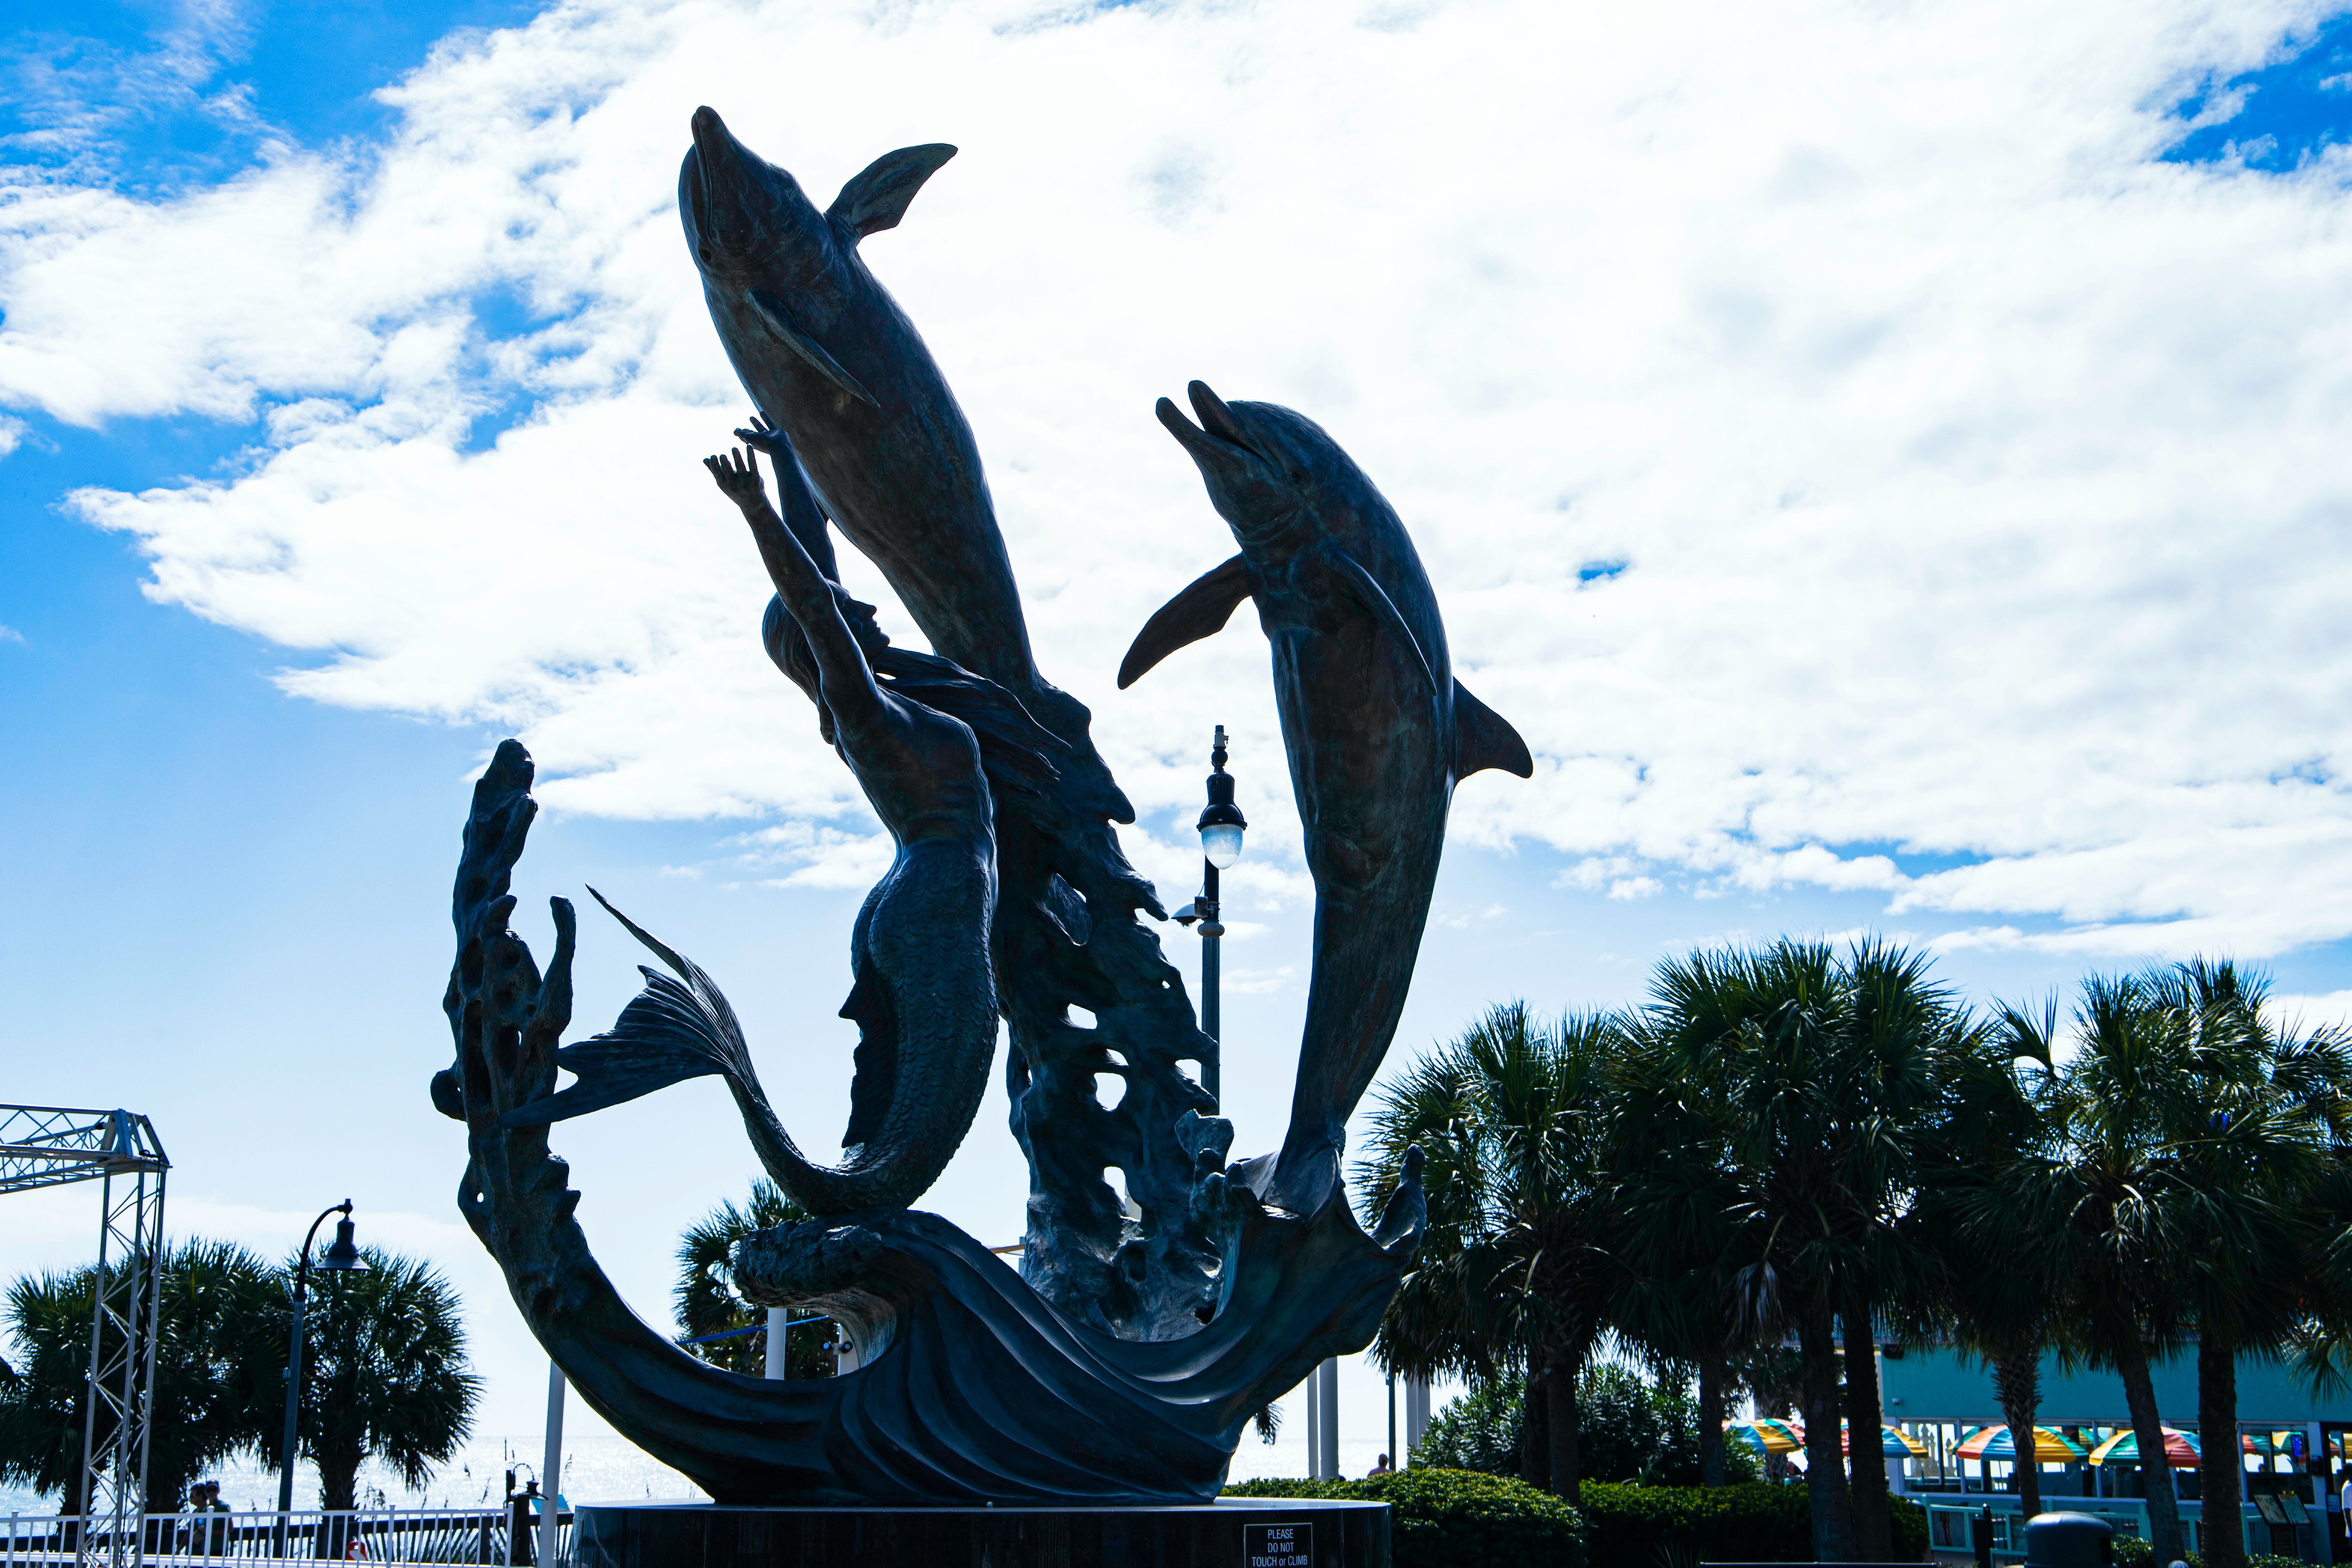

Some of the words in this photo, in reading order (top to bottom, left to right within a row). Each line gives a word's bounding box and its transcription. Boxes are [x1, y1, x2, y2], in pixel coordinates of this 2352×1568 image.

[1268, 1529, 1294, 1539] PLEASE
[1268, 1543, 1278, 1553] DO
[1280, 1542, 1294, 1552] NOT
[1252, 1557, 1277, 1567] TOUCH
[1288, 1555, 1308, 1565] CLIMB
